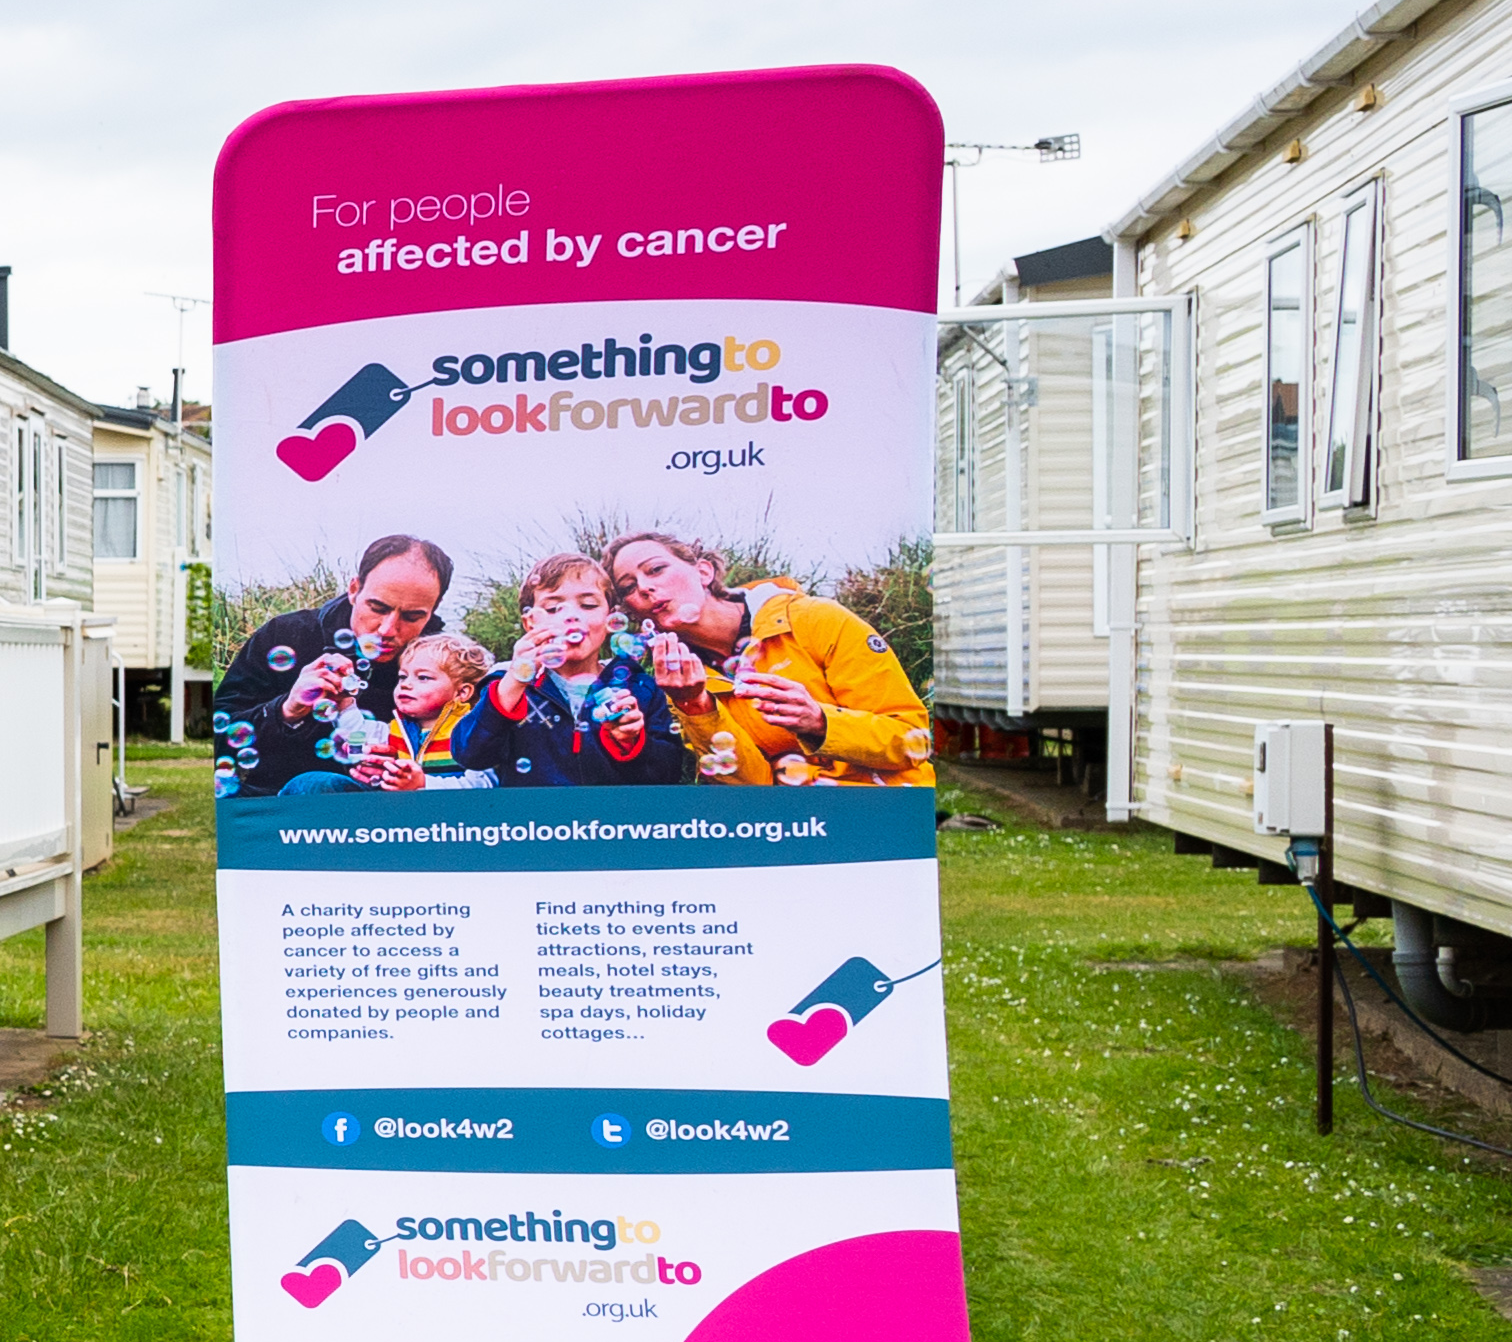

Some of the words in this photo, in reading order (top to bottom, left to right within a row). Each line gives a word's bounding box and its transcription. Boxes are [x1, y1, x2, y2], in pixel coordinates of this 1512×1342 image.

[313, 195, 376, 228] For
[391, 184, 530, 230] people
[338, 230, 528, 273] affected
[546, 229, 599, 267] by
[617, 223, 786, 257] cancer
[432, 333, 782, 383] somethingto
[432, 383, 828, 436] lookforwardto
[666, 441, 765, 475] .org.uk
[279, 817, 827, 846] www.somethingtolookforwardto.org.uk
[282, 904, 294, 916] A
[301, 904, 363, 919] charity
[370, 904, 470, 918] supporting
[536, 902, 576, 914] Find
[583, 901, 664, 917] anything
[672, 901, 716, 913] from
[283, 924, 344, 939] people
[351, 923, 426, 936] affected
[433, 923, 454, 938] by
[536, 923, 600, 935] tickets
[607, 923, 625, 935] to
[632, 922, 695, 934] events
[703, 921, 737, 934] and
[284, 947, 347, 957] cancer
[353, 945, 370, 956] to
[377, 947, 442, 956] access
[449, 947, 459, 956] a
[538, 944, 646, 957] attractions,
[654, 943, 753, 955] restaurant
[285, 966, 345, 980] variety
[353, 965, 369, 977] of
[375, 965, 411, 977] free
[418, 964, 458, 980] gifts
[465, 964, 498, 977] and
[539, 964, 600, 978] meals,
[607, 964, 654, 976] hotel
[662, 964, 717, 979] stays,
[286, 985, 397, 1000] experiences
[404, 985, 507, 1000] generously
[539, 985, 603, 1000] beauty
[610, 985, 720, 999] treatments,
[287, 1006, 361, 1018] donated
[368, 1006, 389, 1021] by
[396, 1006, 458, 1021] people
[465, 1006, 499, 1018] and
[540, 1009, 573, 1021] spa
[581, 1005, 630, 1021] days,
[637, 1005, 706, 1021] holiday
[288, 1029, 393, 1041] companies.
[542, 1027, 644, 1041] cottages...
[374, 1117, 514, 1138] @look4w2
[646, 1119, 789, 1140] @look4w2
[396, 1210, 659, 1251] somethingto
[400, 1251, 702, 1285] lookforwardto
[583, 1299, 657, 1322] .org.uk
